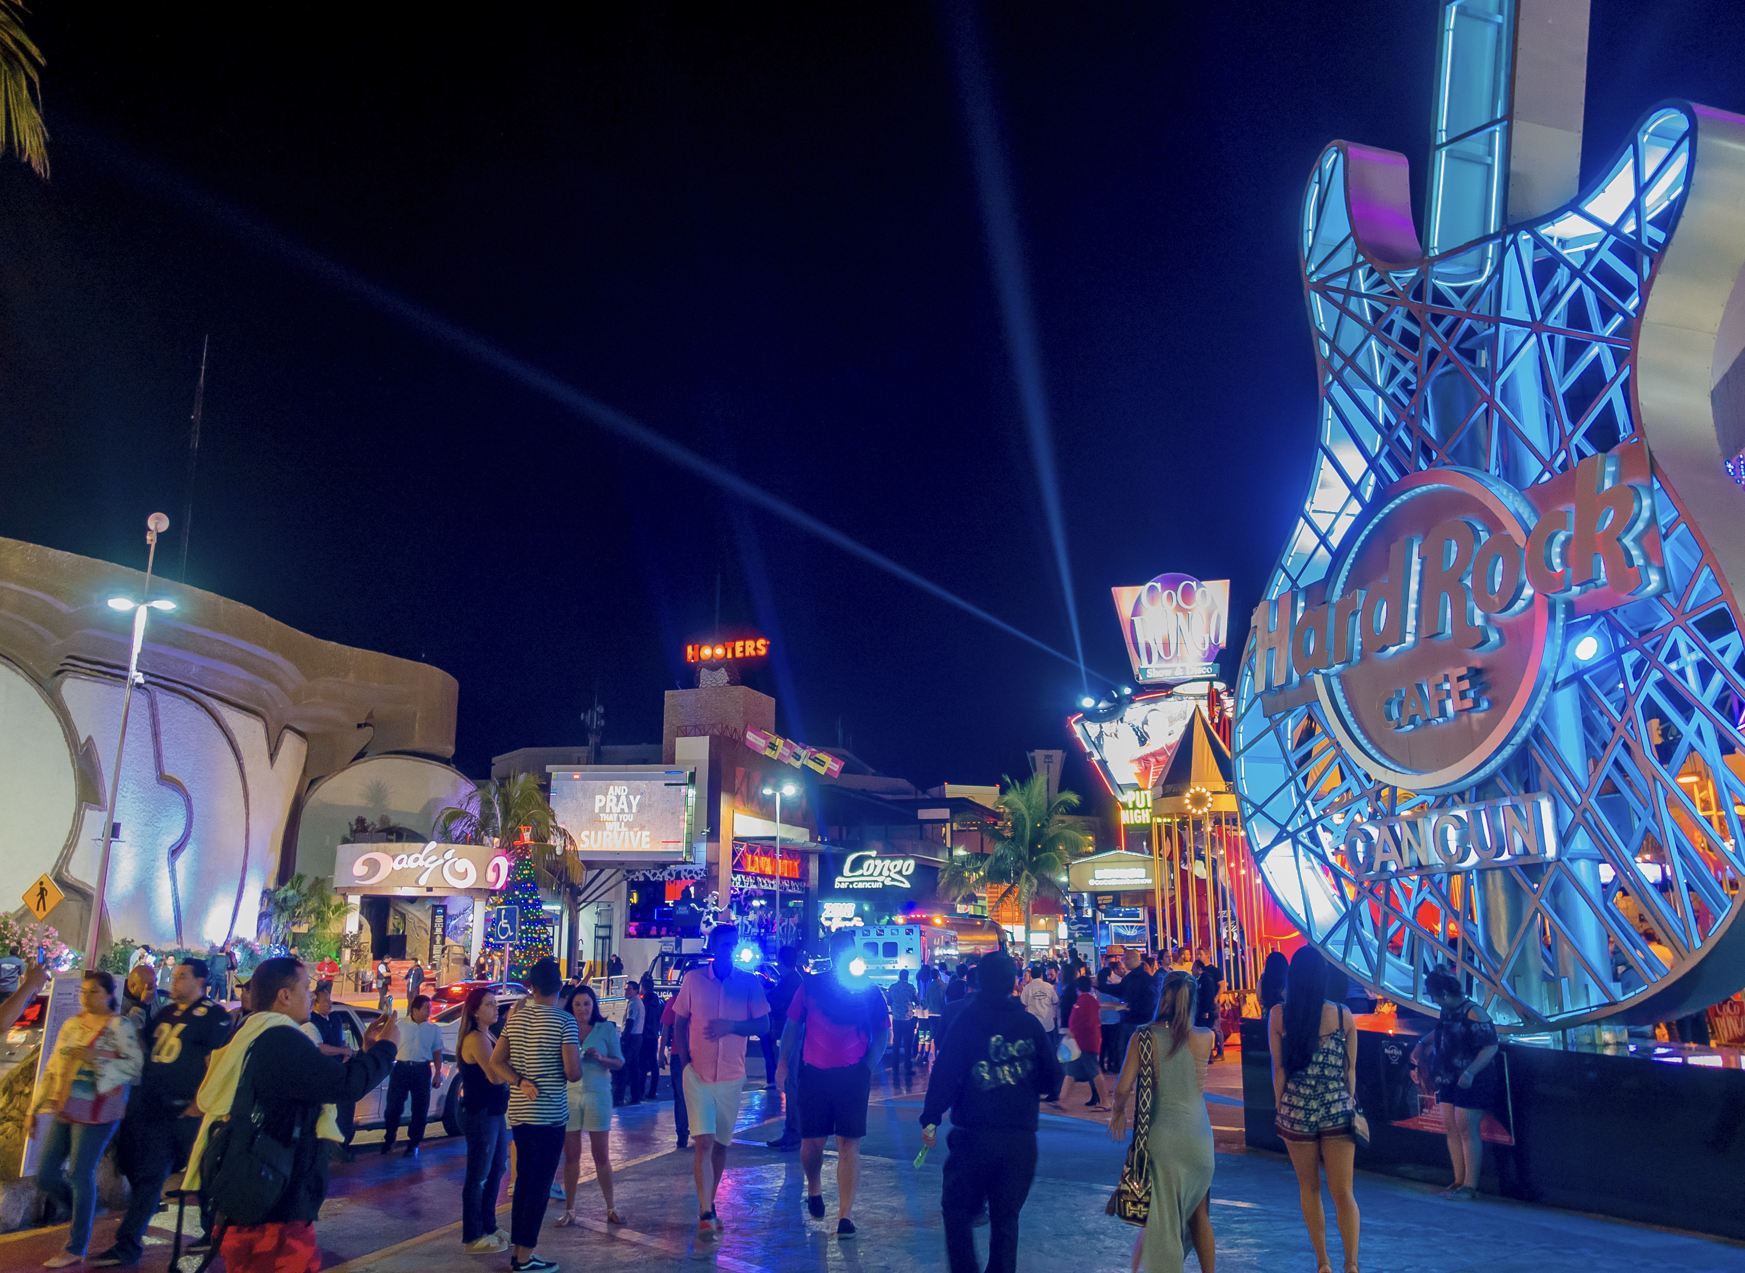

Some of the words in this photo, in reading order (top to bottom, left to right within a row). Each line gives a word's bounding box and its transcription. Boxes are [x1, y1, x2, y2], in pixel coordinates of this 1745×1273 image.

[1253, 534, 1418, 694] Hard
[1418, 453, 1658, 656] Rock
[686, 638, 767, 662] HOOTERS
[1378, 665, 1488, 733] CAFE
[607, 786, 628, 796] AND
[594, 794, 641, 813] PRAY
[599, 813, 617, 822] THAT
[618, 813, 634, 822] YOU
[605, 821, 628, 832] WILL
[580, 830, 650, 849] SURVIVE
[1344, 800, 1548, 874] CANCUN
[843, 850, 915, 888] Congo
